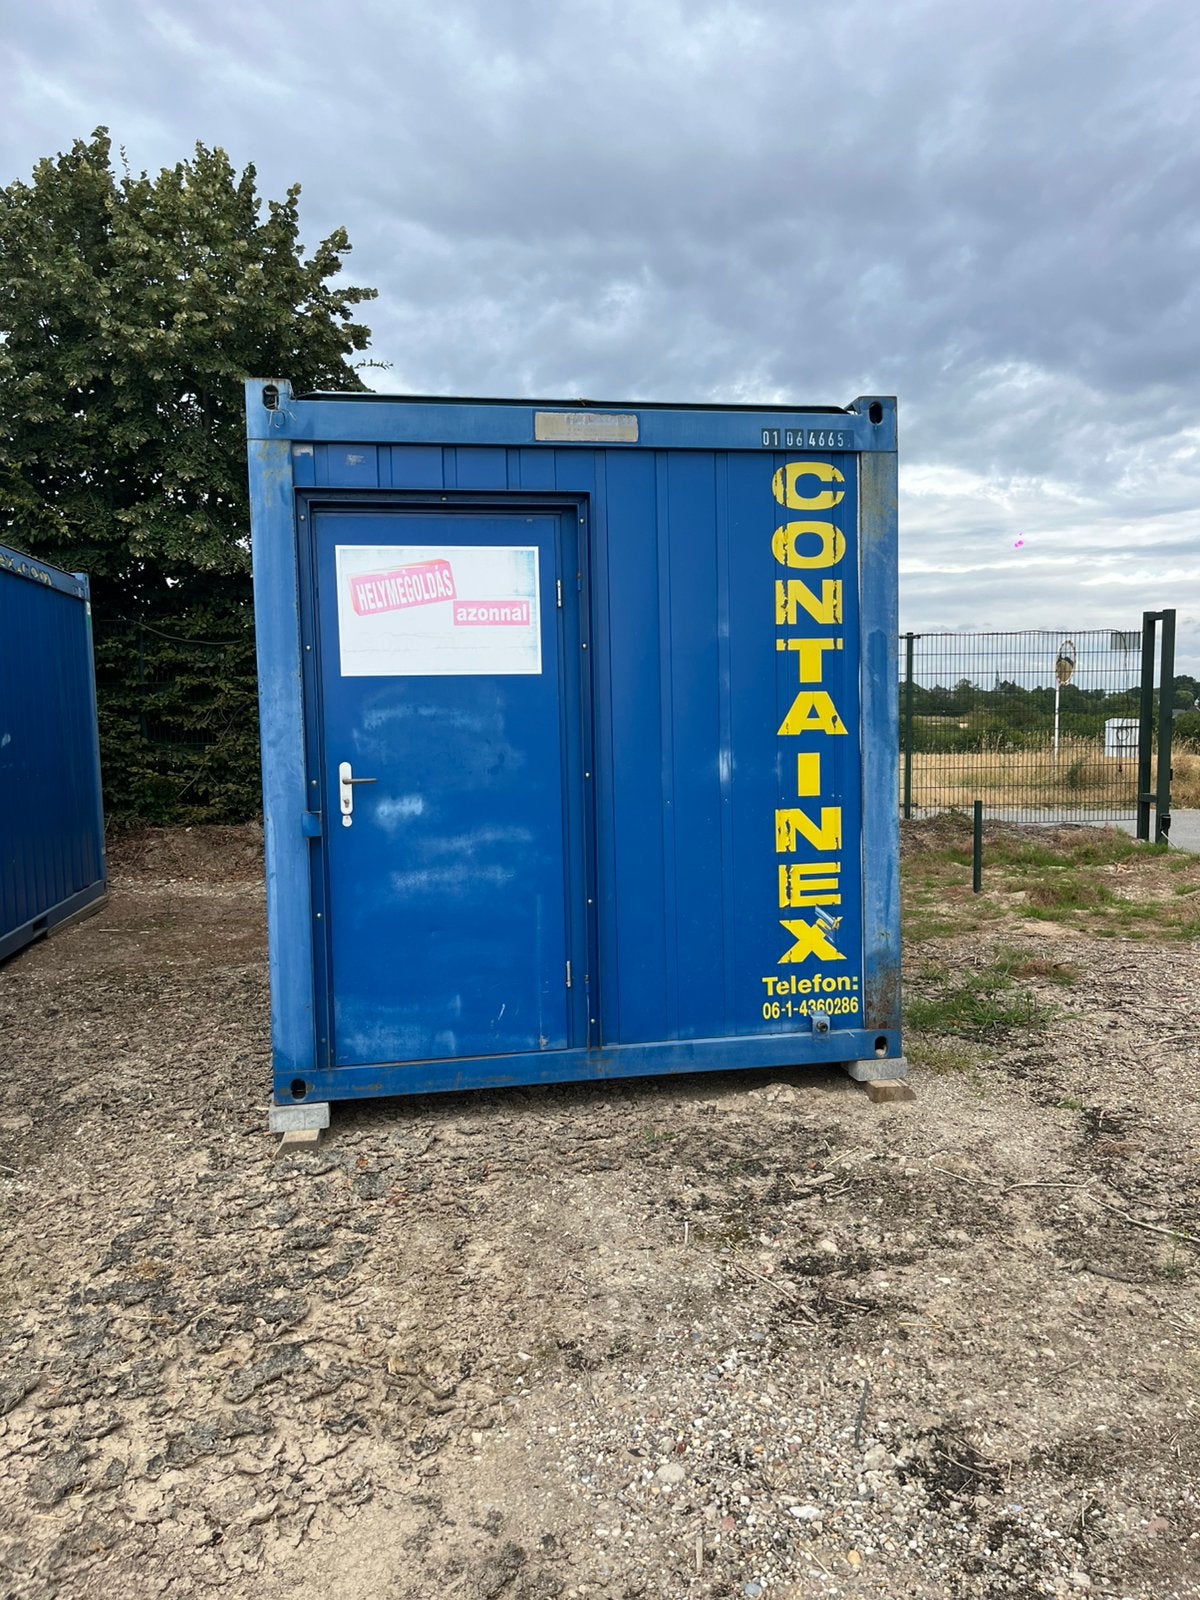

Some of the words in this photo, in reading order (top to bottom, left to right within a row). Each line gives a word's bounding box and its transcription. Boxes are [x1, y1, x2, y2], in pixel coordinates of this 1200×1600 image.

[763, 431, 778, 446] 01
[787, 432, 803, 447] 06
[456, 603, 528, 622] azonnal
[771, 461, 849, 964] CONTAINEX
[762, 973, 859, 996] Telefon:
[762, 996, 859, 1020] 06-1-4360286
